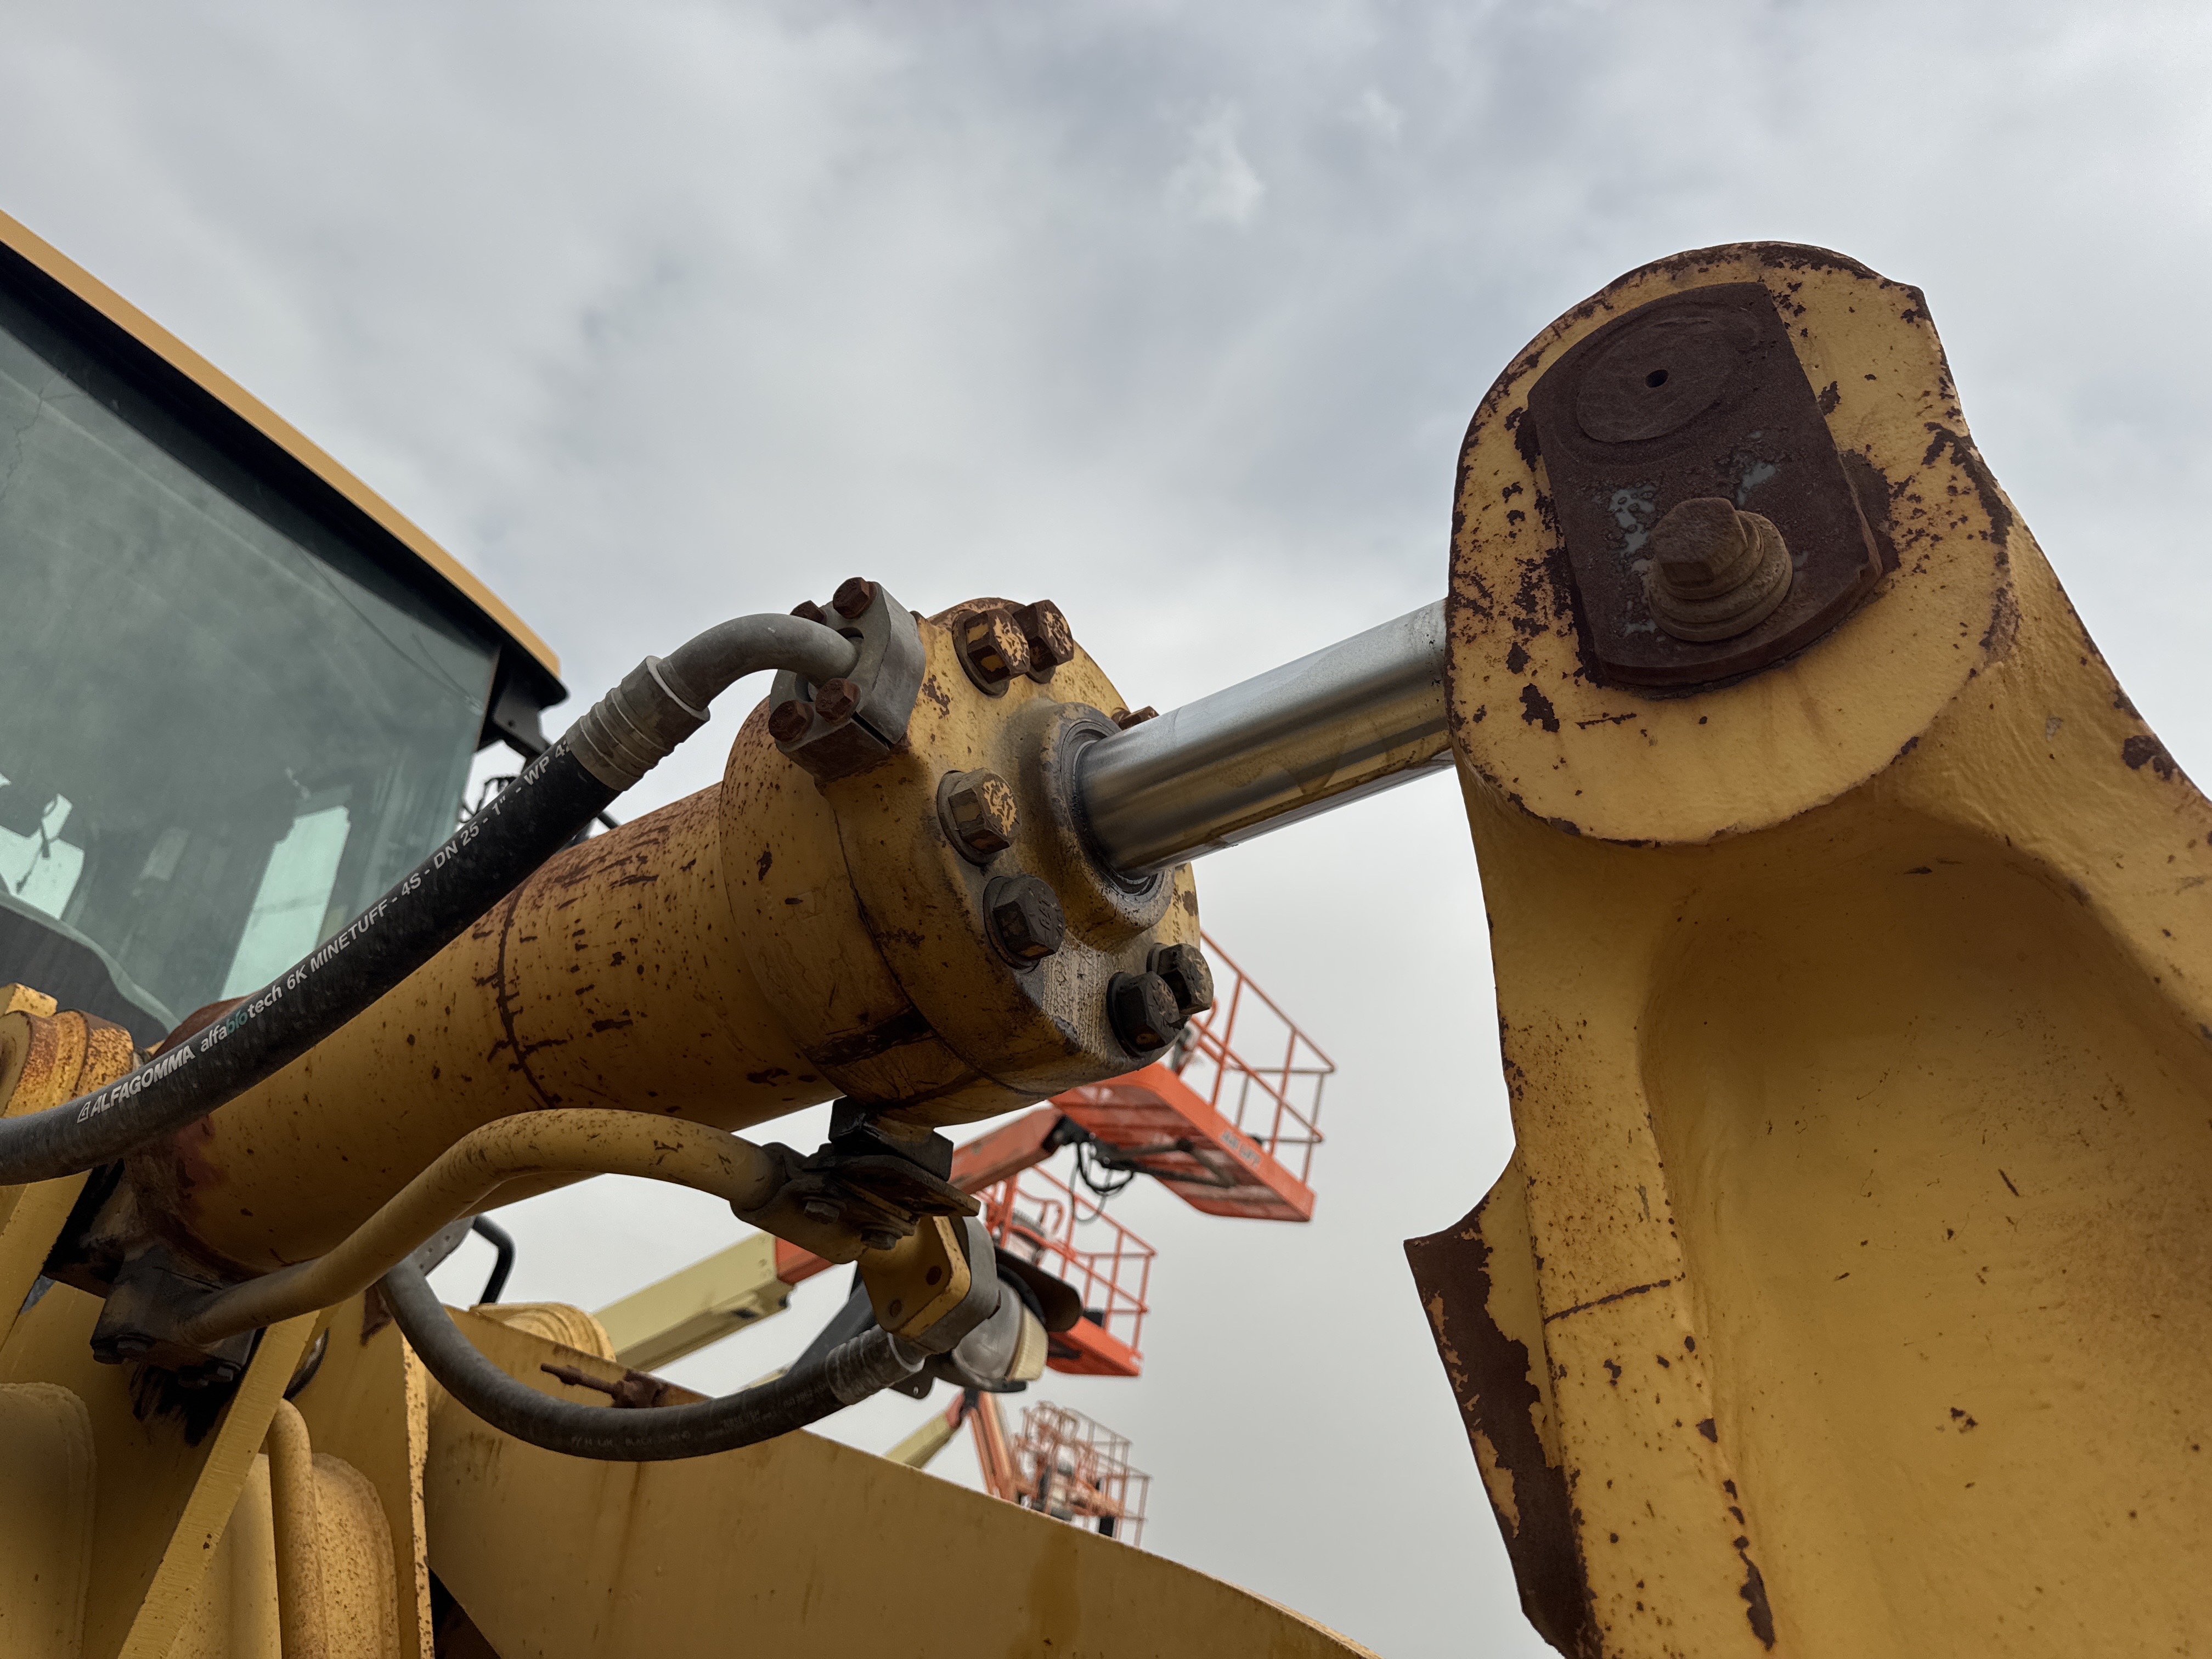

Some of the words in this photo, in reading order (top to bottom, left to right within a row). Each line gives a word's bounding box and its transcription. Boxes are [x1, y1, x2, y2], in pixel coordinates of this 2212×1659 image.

[90, 1045, 196, 1117] ALFAGOMMA
[287, 964, 308, 990] 6K
[310, 899, 388, 972] MINETUFF
[401, 873, 421, 897] 4S
[433, 840, 459, 869] DN
[460, 823, 479, 846] 25
[523, 756, 550, 785] WP
